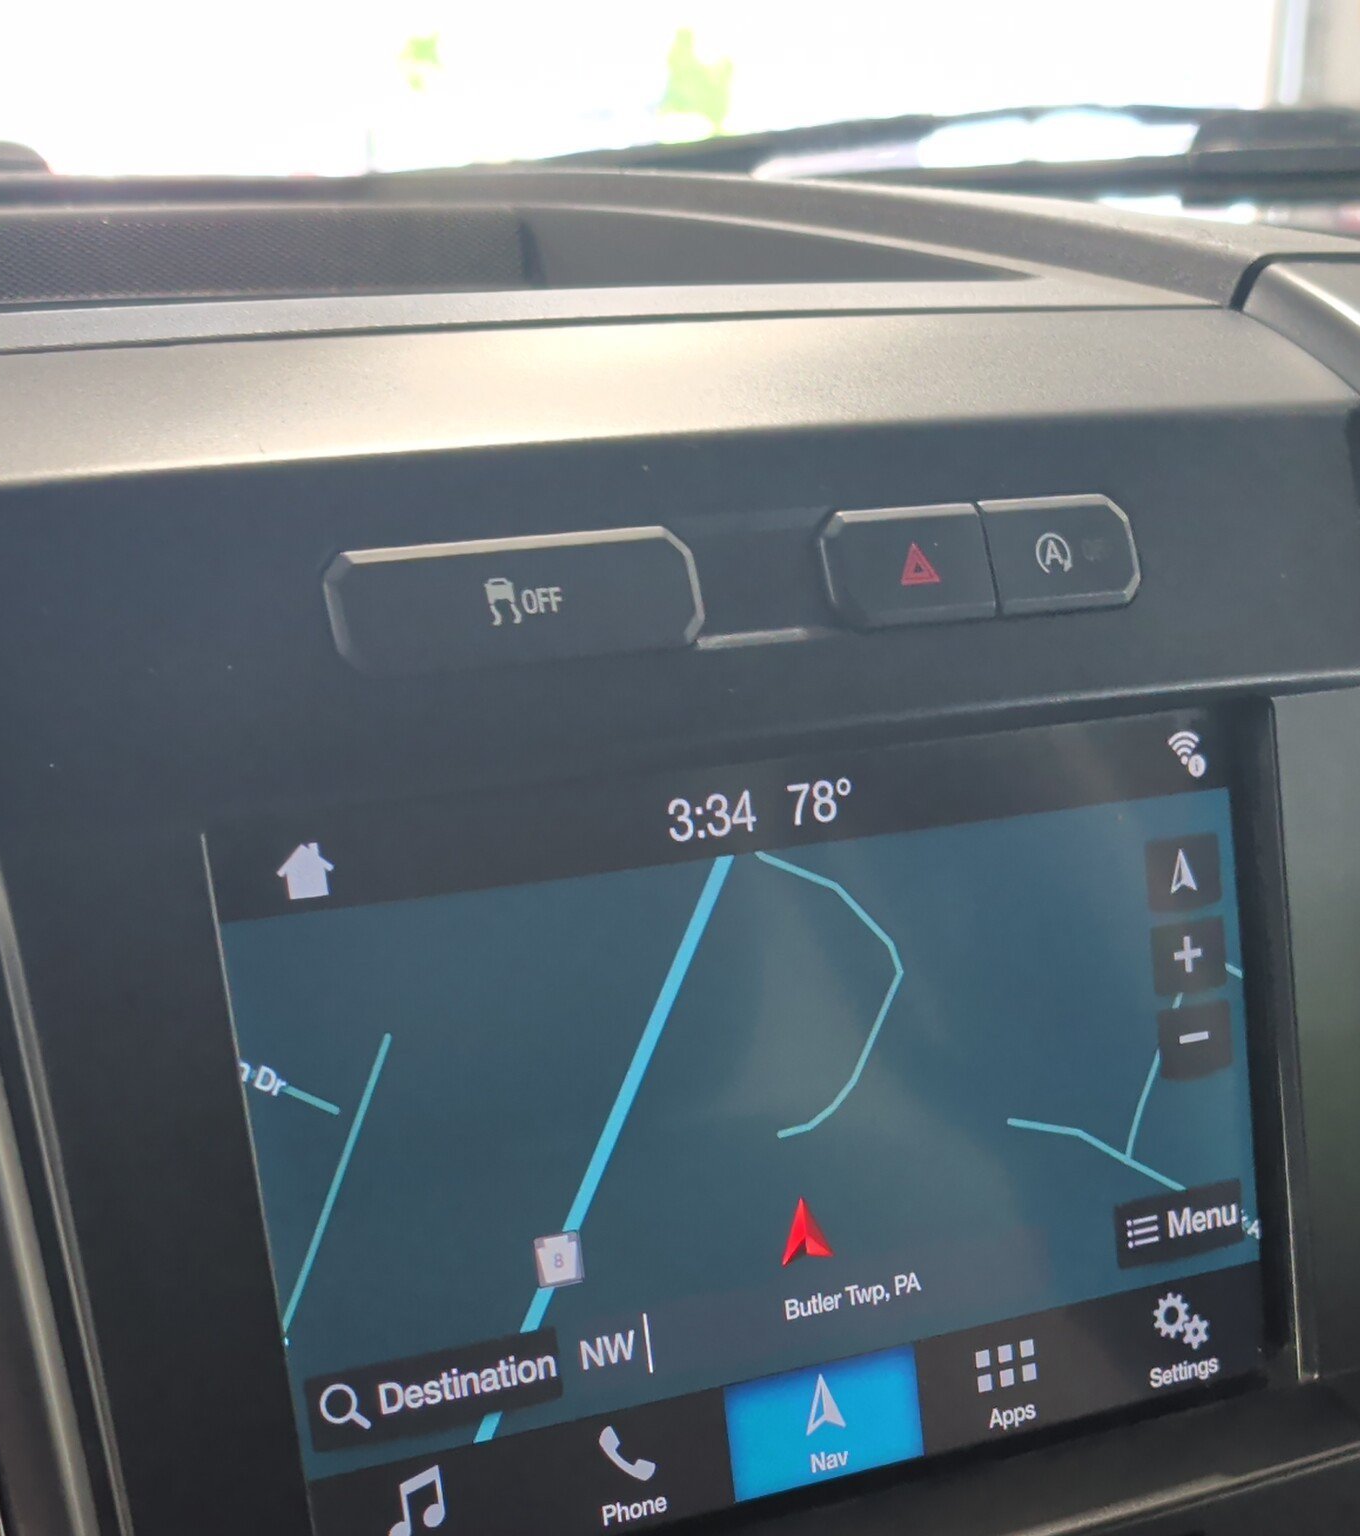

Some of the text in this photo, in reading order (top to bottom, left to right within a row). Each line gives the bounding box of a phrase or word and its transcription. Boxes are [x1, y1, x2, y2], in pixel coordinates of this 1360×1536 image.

[521, 586, 563, 614] OFF
[667, 777, 852, 842] 3:34 78°
[254, 1065, 287, 1096] Dr
[1167, 1202, 1238, 1239] Menu
[553, 1253, 565, 1268] 8
[784, 1271, 922, 1320] Butler Twp, PA
[579, 1329, 635, 1371] NW
[378, 1354, 557, 1416] Destination
[1149, 1357, 1219, 1388] Settings
[989, 1403, 1037, 1431] Apps
[810, 1450, 849, 1474] Nav
[601, 1495, 668, 1527] Phone
